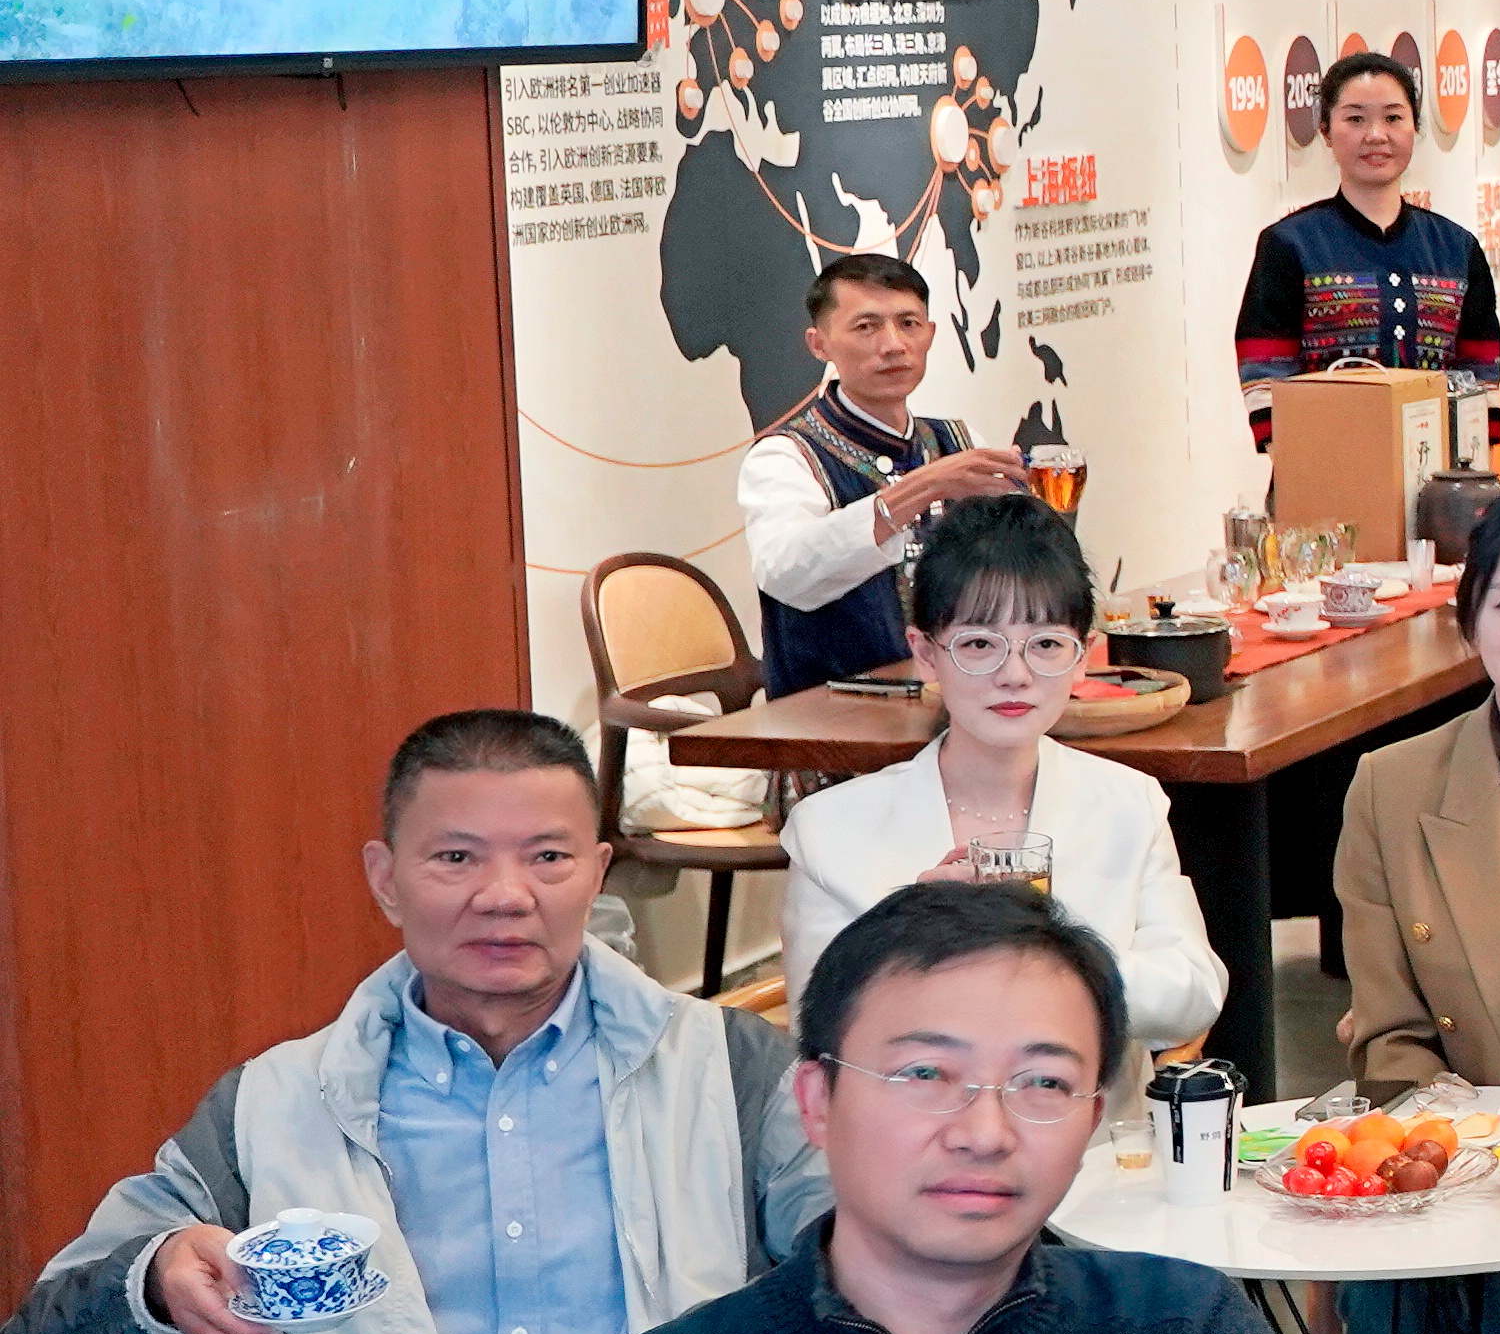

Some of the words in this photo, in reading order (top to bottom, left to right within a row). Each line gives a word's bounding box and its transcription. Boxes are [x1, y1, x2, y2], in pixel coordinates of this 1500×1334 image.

[1228, 74, 1267, 112] 1994
[1438, 64, 1468, 97] 2015
[1021, 153, 1097, 207] 上海枢纽
